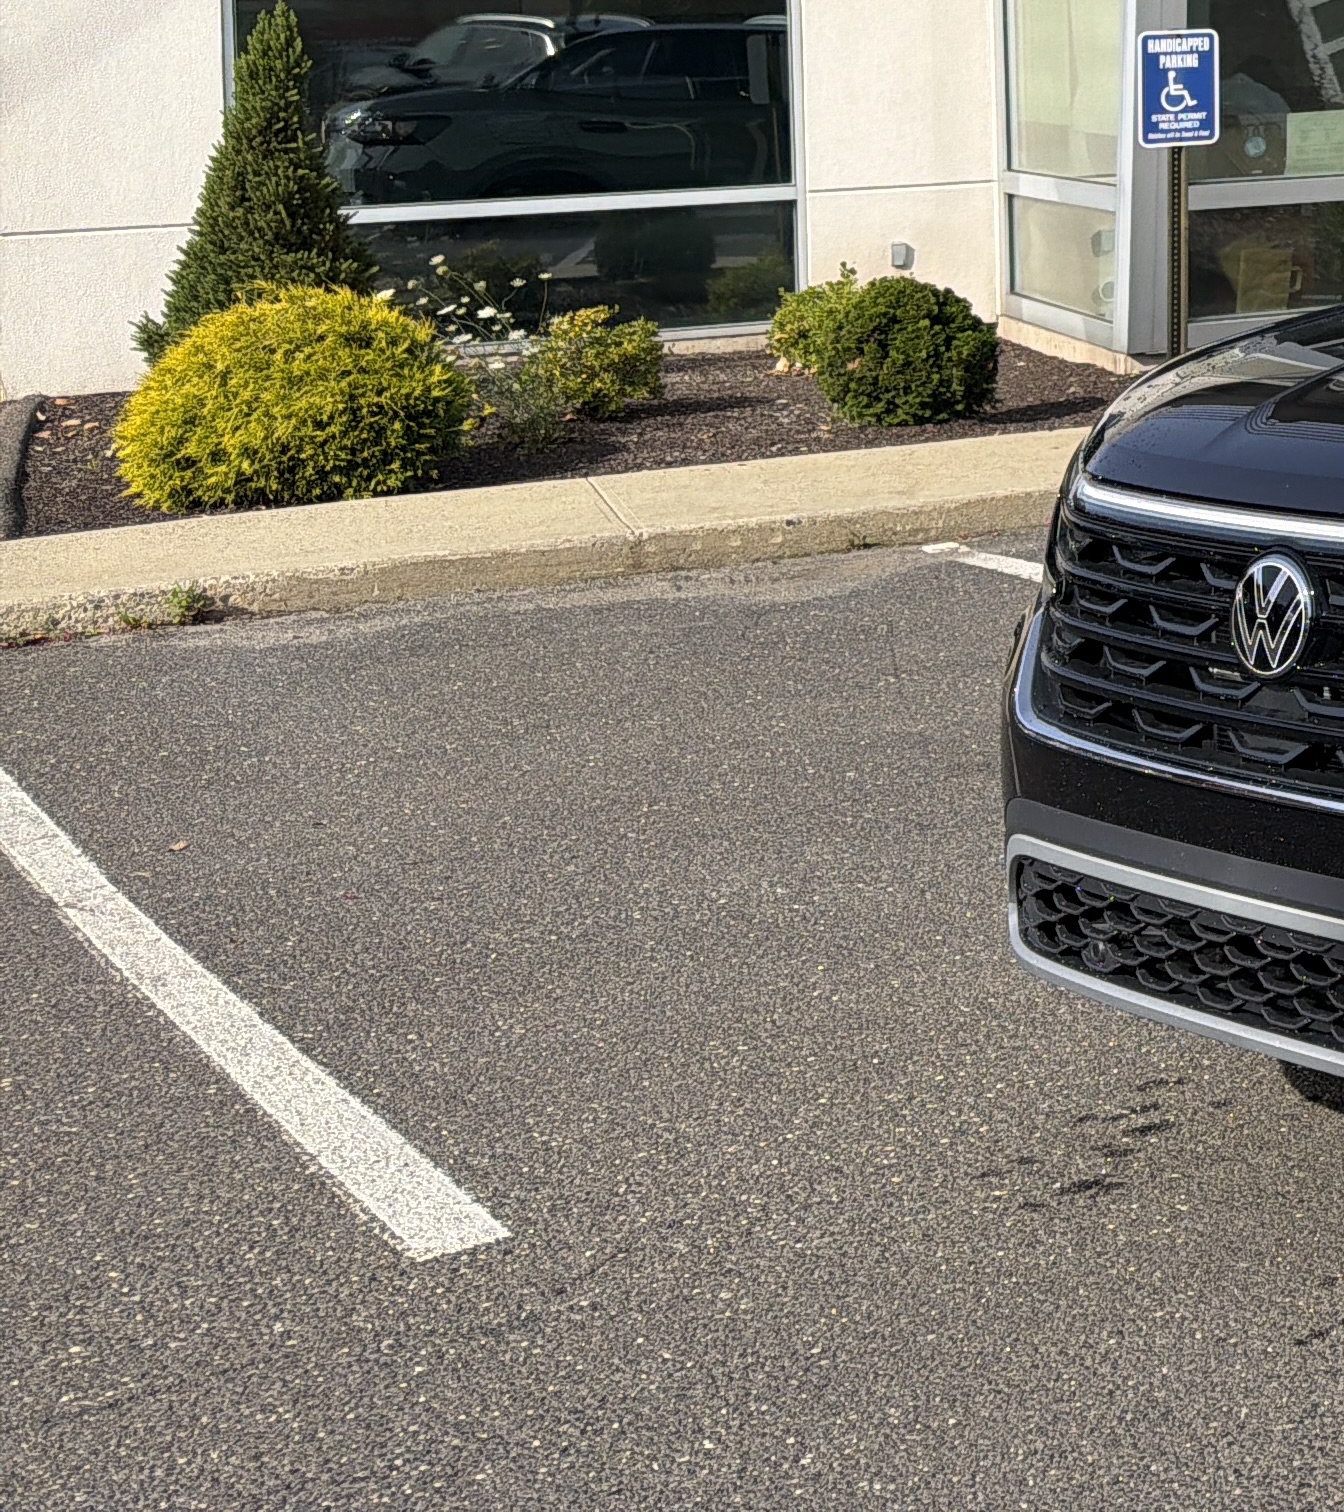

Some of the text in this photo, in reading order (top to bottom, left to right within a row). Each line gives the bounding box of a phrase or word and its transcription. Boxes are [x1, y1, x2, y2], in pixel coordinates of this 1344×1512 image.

[1147, 36, 1210, 54] HANDICAPPED
[1159, 53, 1199, 69] PARKING
[1151, 111, 1208, 123] STATE PERMIT
[1158, 120, 1200, 130] REQUIRED
